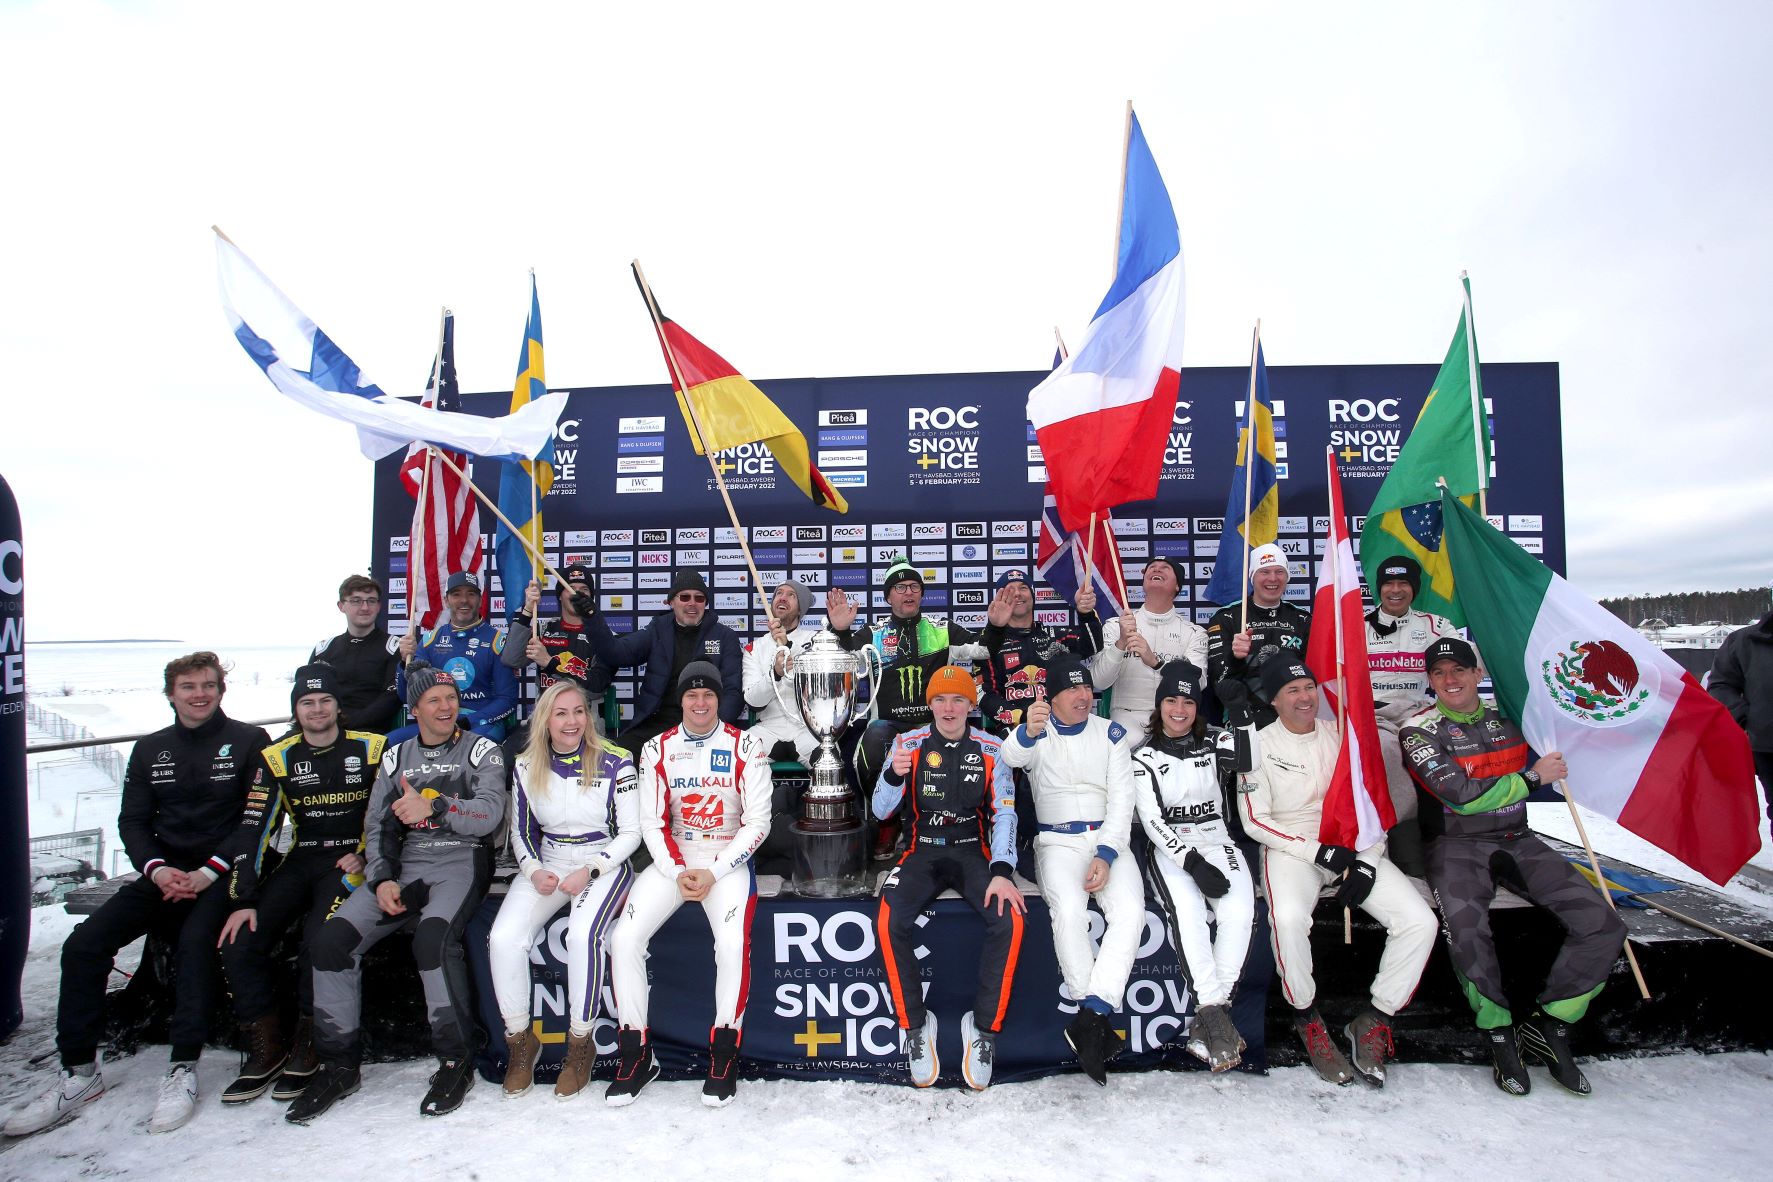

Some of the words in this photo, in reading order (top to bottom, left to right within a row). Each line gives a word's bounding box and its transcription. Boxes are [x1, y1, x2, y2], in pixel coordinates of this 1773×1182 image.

[1329, 398, 1400, 423] ROC
[831, 413, 854, 423] Piteå
[908, 406, 978, 430] ROC
[1330, 430, 1400, 446] SNOW
[908, 437, 978, 453] SNOW
[958, 526, 981, 535] Piteå
[1200, 521, 1222, 530] Piteå
[643, 532, 665, 542] Piteå
[798, 529, 821, 538] Piteå
[1282, 542, 1301, 552] svt
[880, 549, 898, 560] svt
[800, 572, 819, 583] svt
[959, 593, 981, 602] Piteå
[712, 754, 729, 767] 1&1
[670, 777, 732, 788] URALKALI
[304, 789, 368, 806] GAINBRIDGE
[1164, 800, 1215, 818] VELOCE
[730, 832, 765, 868] URALKALI
[774, 968, 811, 979] RACE
[818, 968, 837, 978] OF
